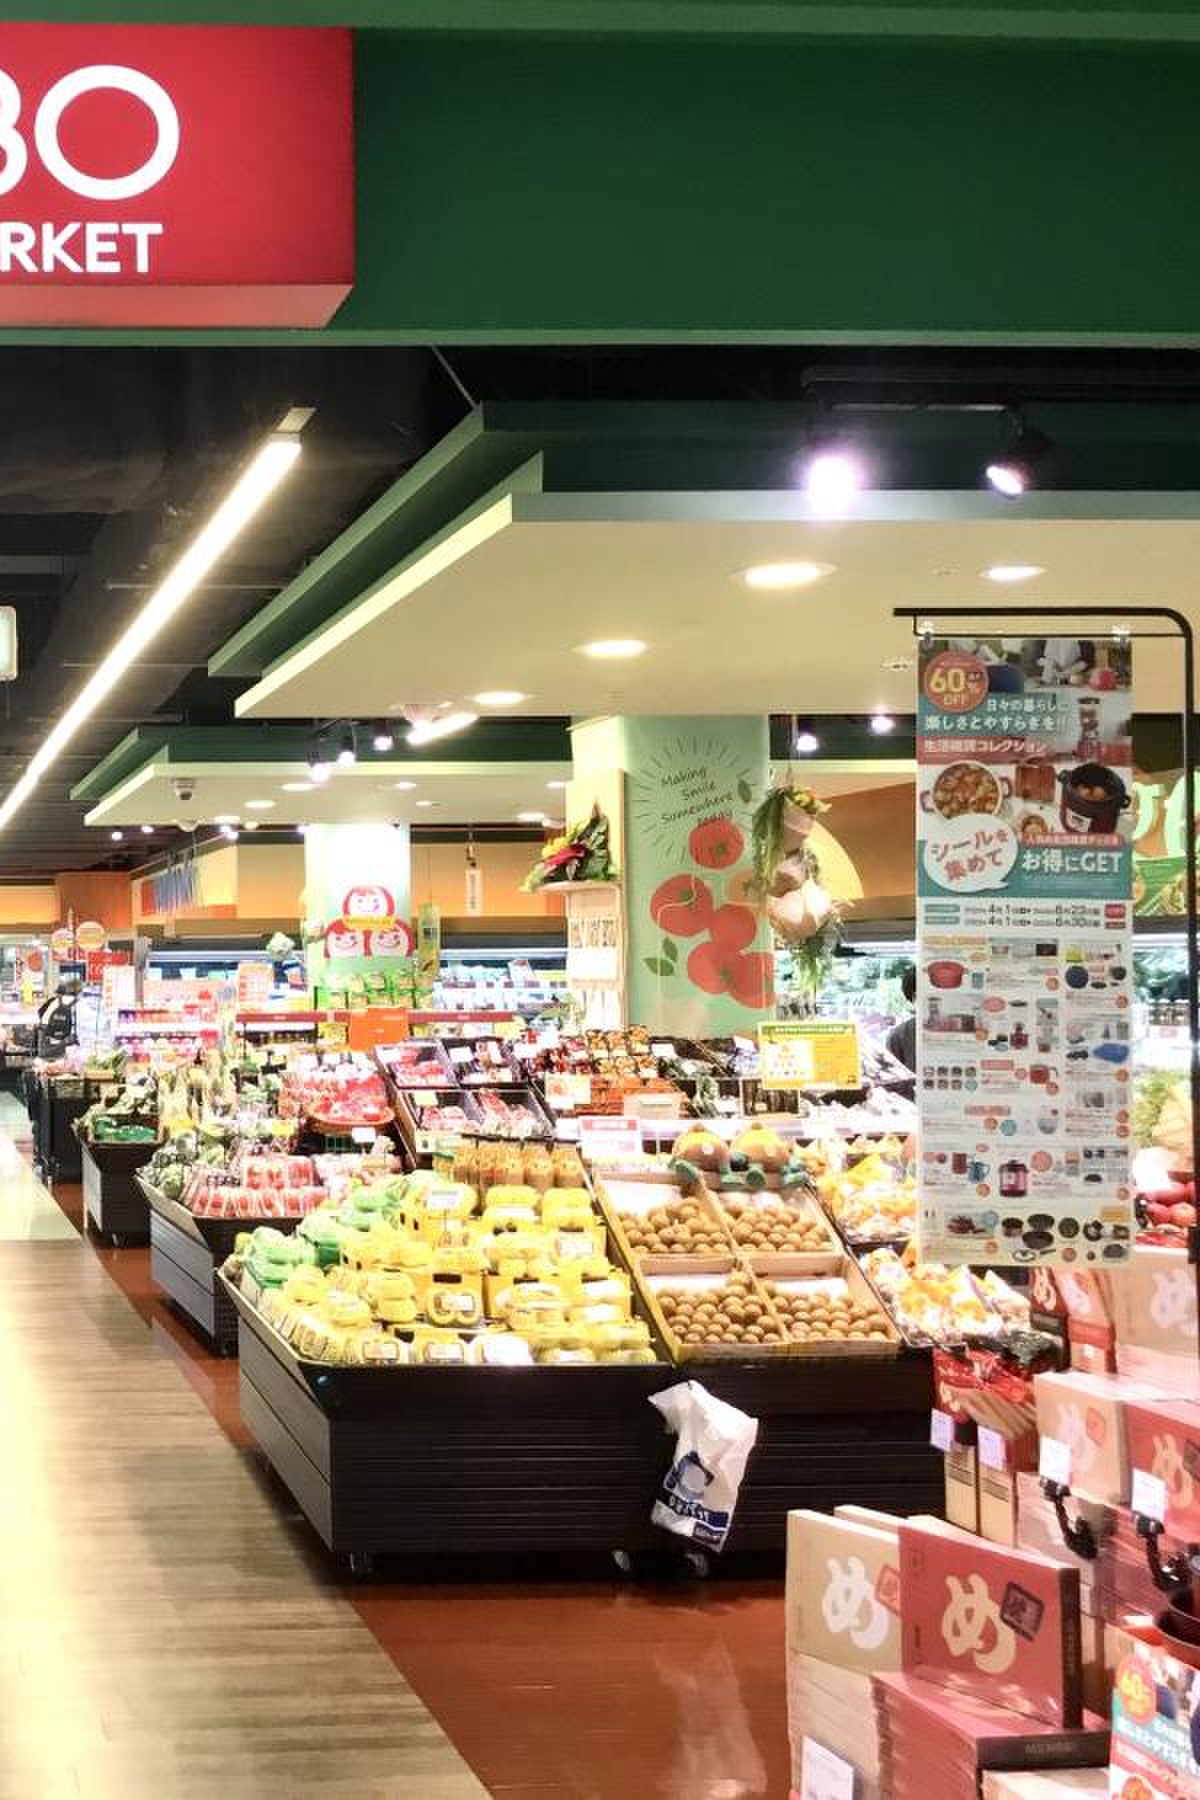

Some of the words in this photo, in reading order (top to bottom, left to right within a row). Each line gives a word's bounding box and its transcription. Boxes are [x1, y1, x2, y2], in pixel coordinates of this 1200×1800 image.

[661, 765, 707, 789] Making
[680, 779, 717, 801] Smile
[1021, 849, 1122, 873] お得にGET
[822, 1555, 890, 1650] め
[941, 1573, 1017, 1676] め
